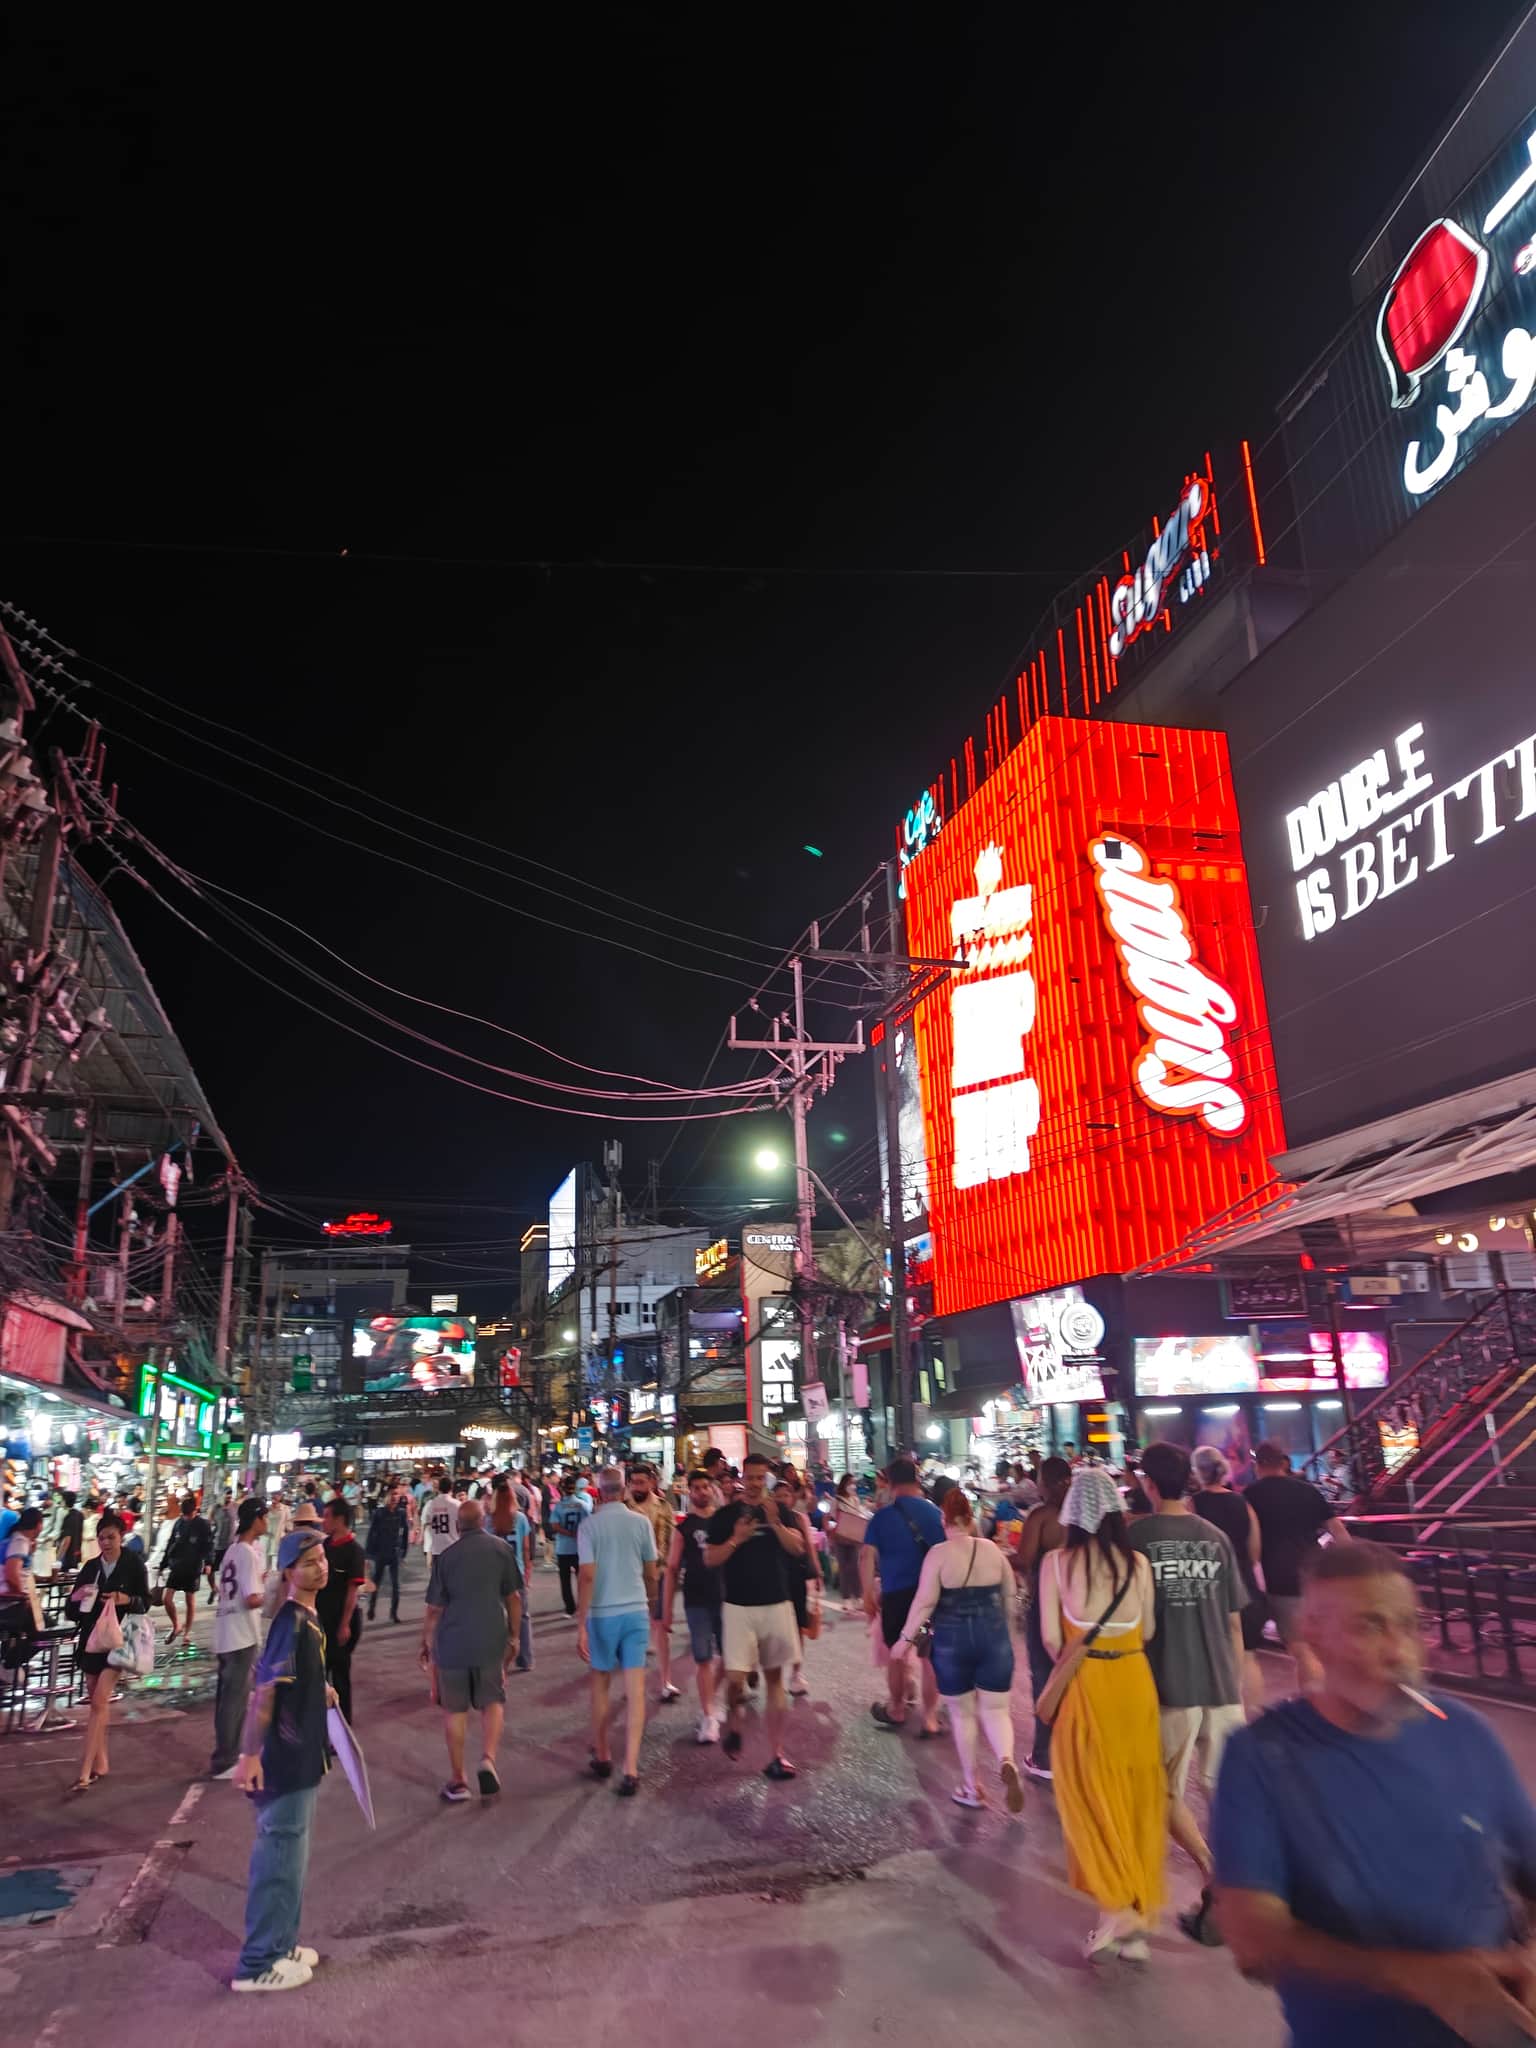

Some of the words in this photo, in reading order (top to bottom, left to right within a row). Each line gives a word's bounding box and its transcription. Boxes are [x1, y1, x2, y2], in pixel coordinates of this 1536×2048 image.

[1286, 721, 1433, 872] DOUBLE
[1296, 868, 1336, 940] IS
[746, 1234, 800, 1245] CENTRA
[431, 1514, 449, 1534] 48
[1152, 1560, 1221, 1580] TEKKY
